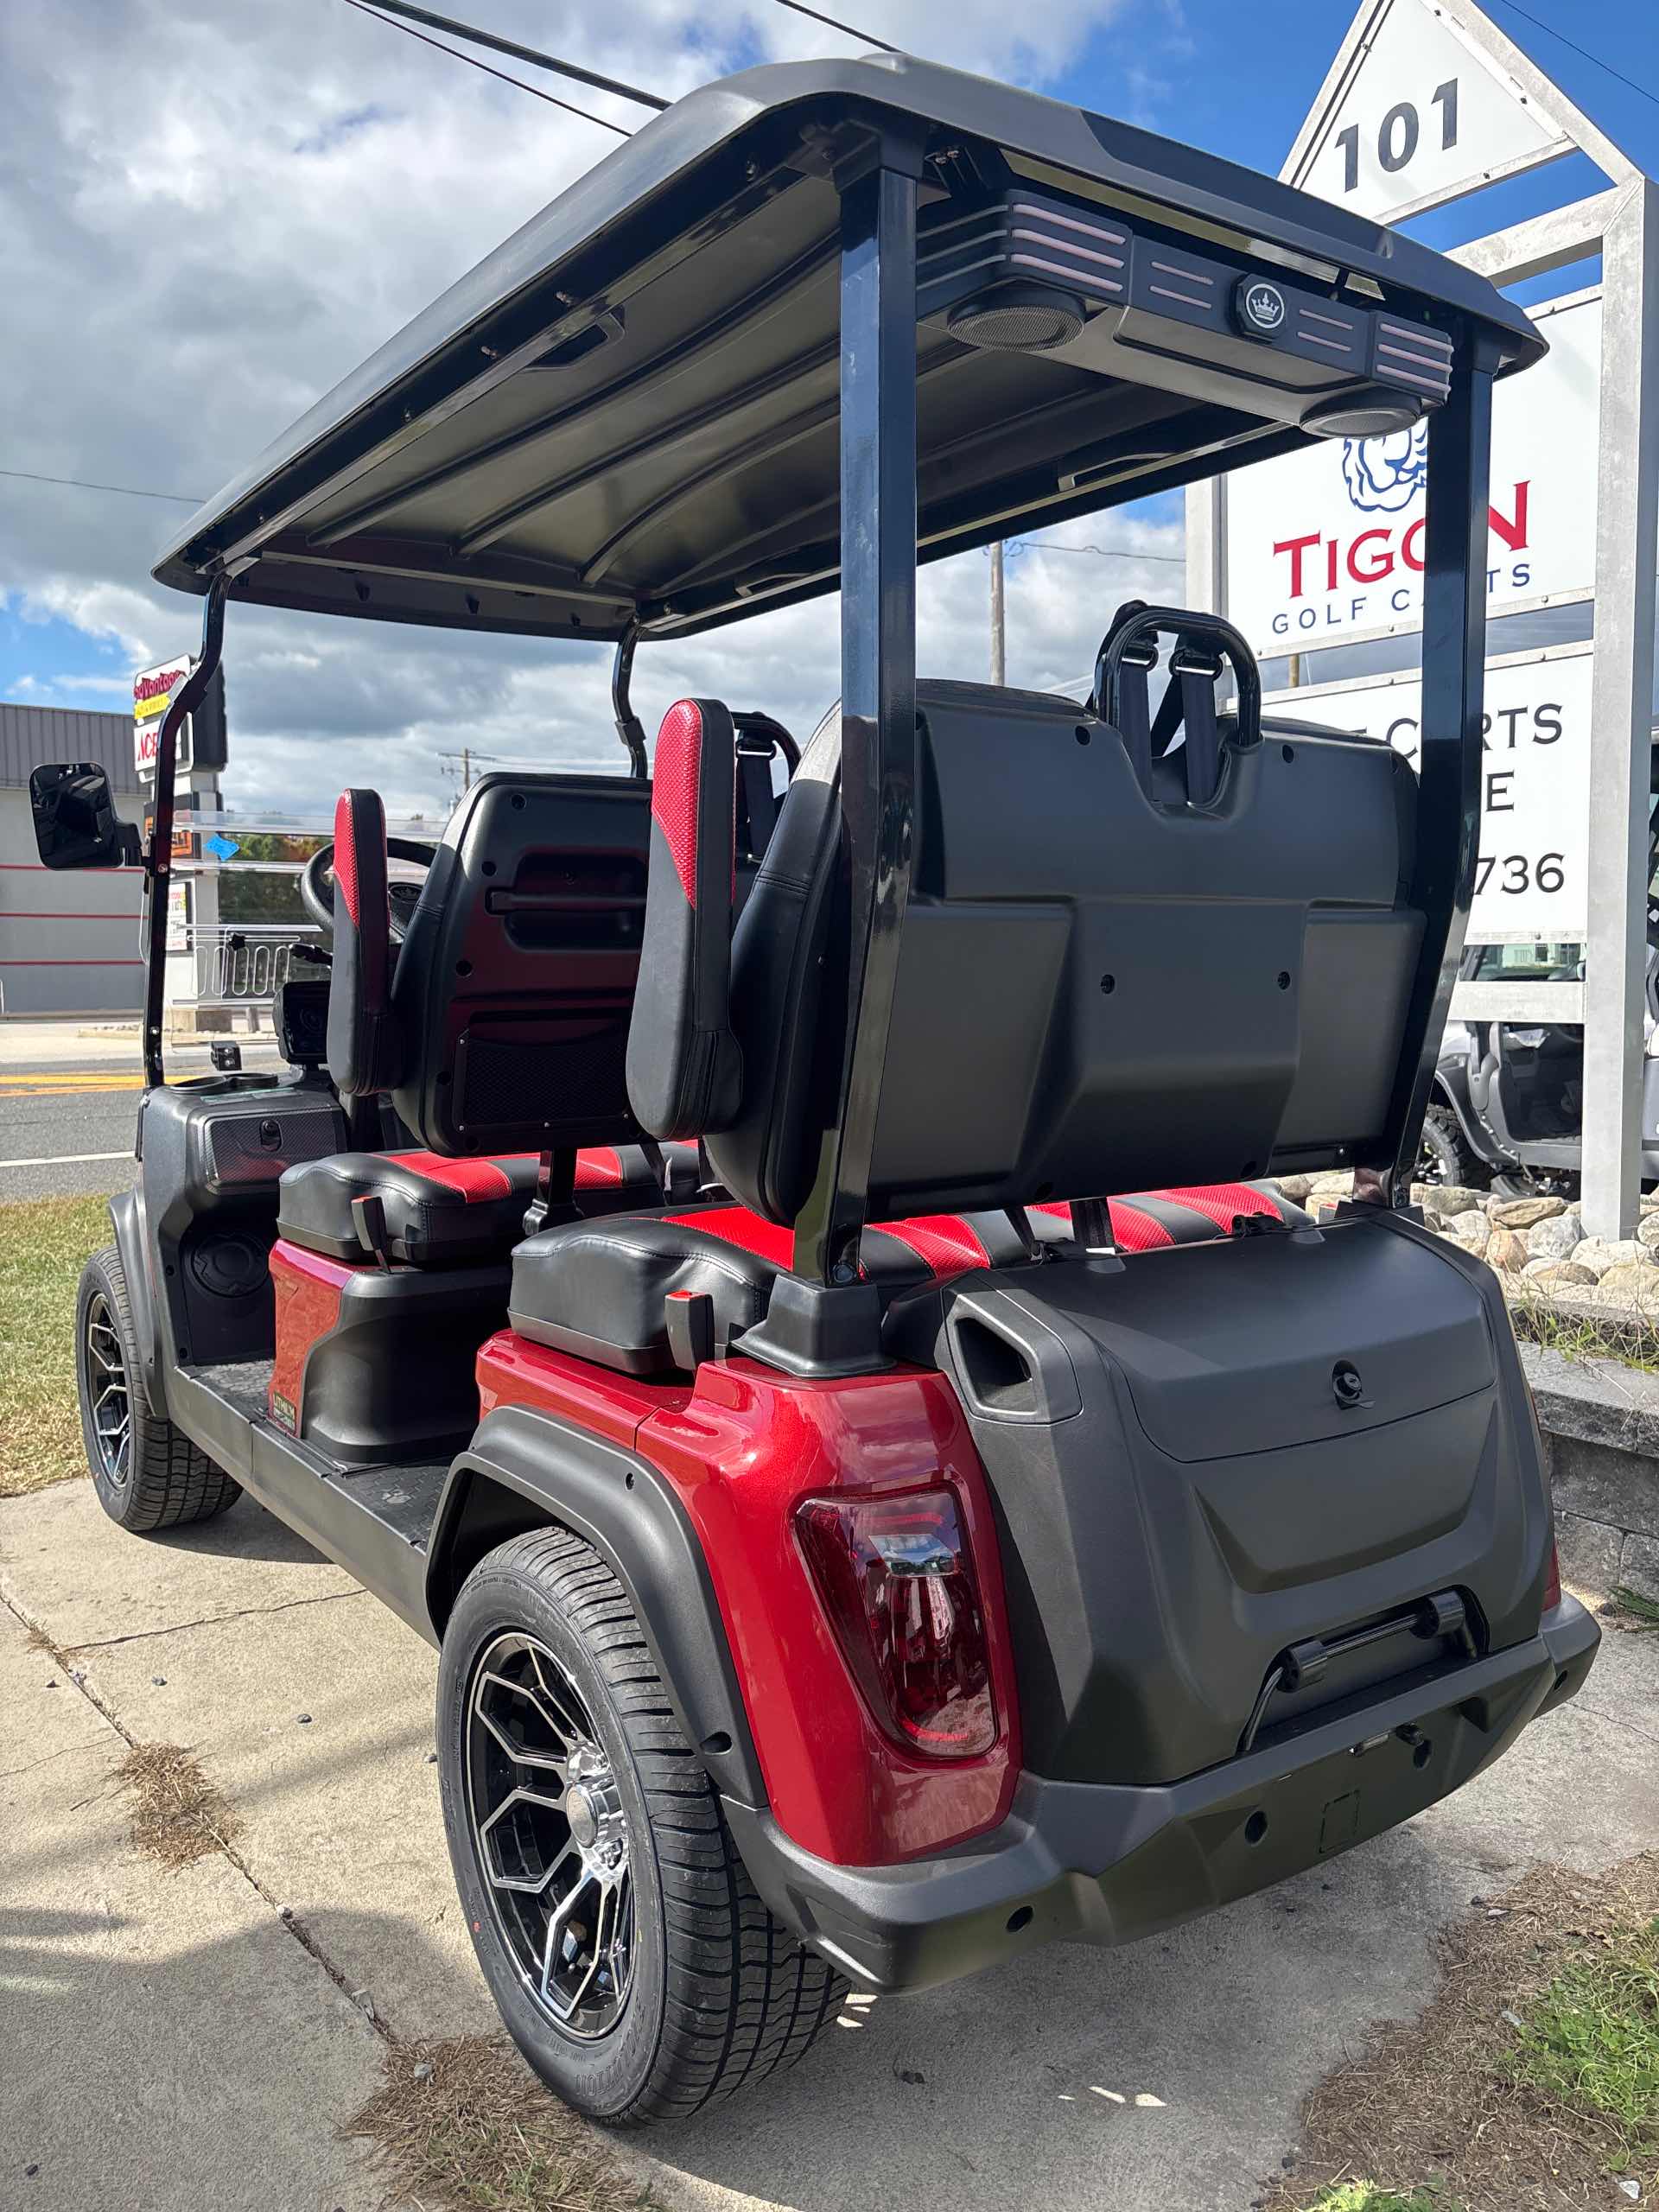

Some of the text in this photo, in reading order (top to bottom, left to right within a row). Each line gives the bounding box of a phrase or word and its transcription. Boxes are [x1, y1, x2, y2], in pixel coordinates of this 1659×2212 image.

[1334, 78, 1459, 193] 101
[1272, 563, 1531, 634] GOLF CTS
[1385, 702, 1563, 760] CTS
